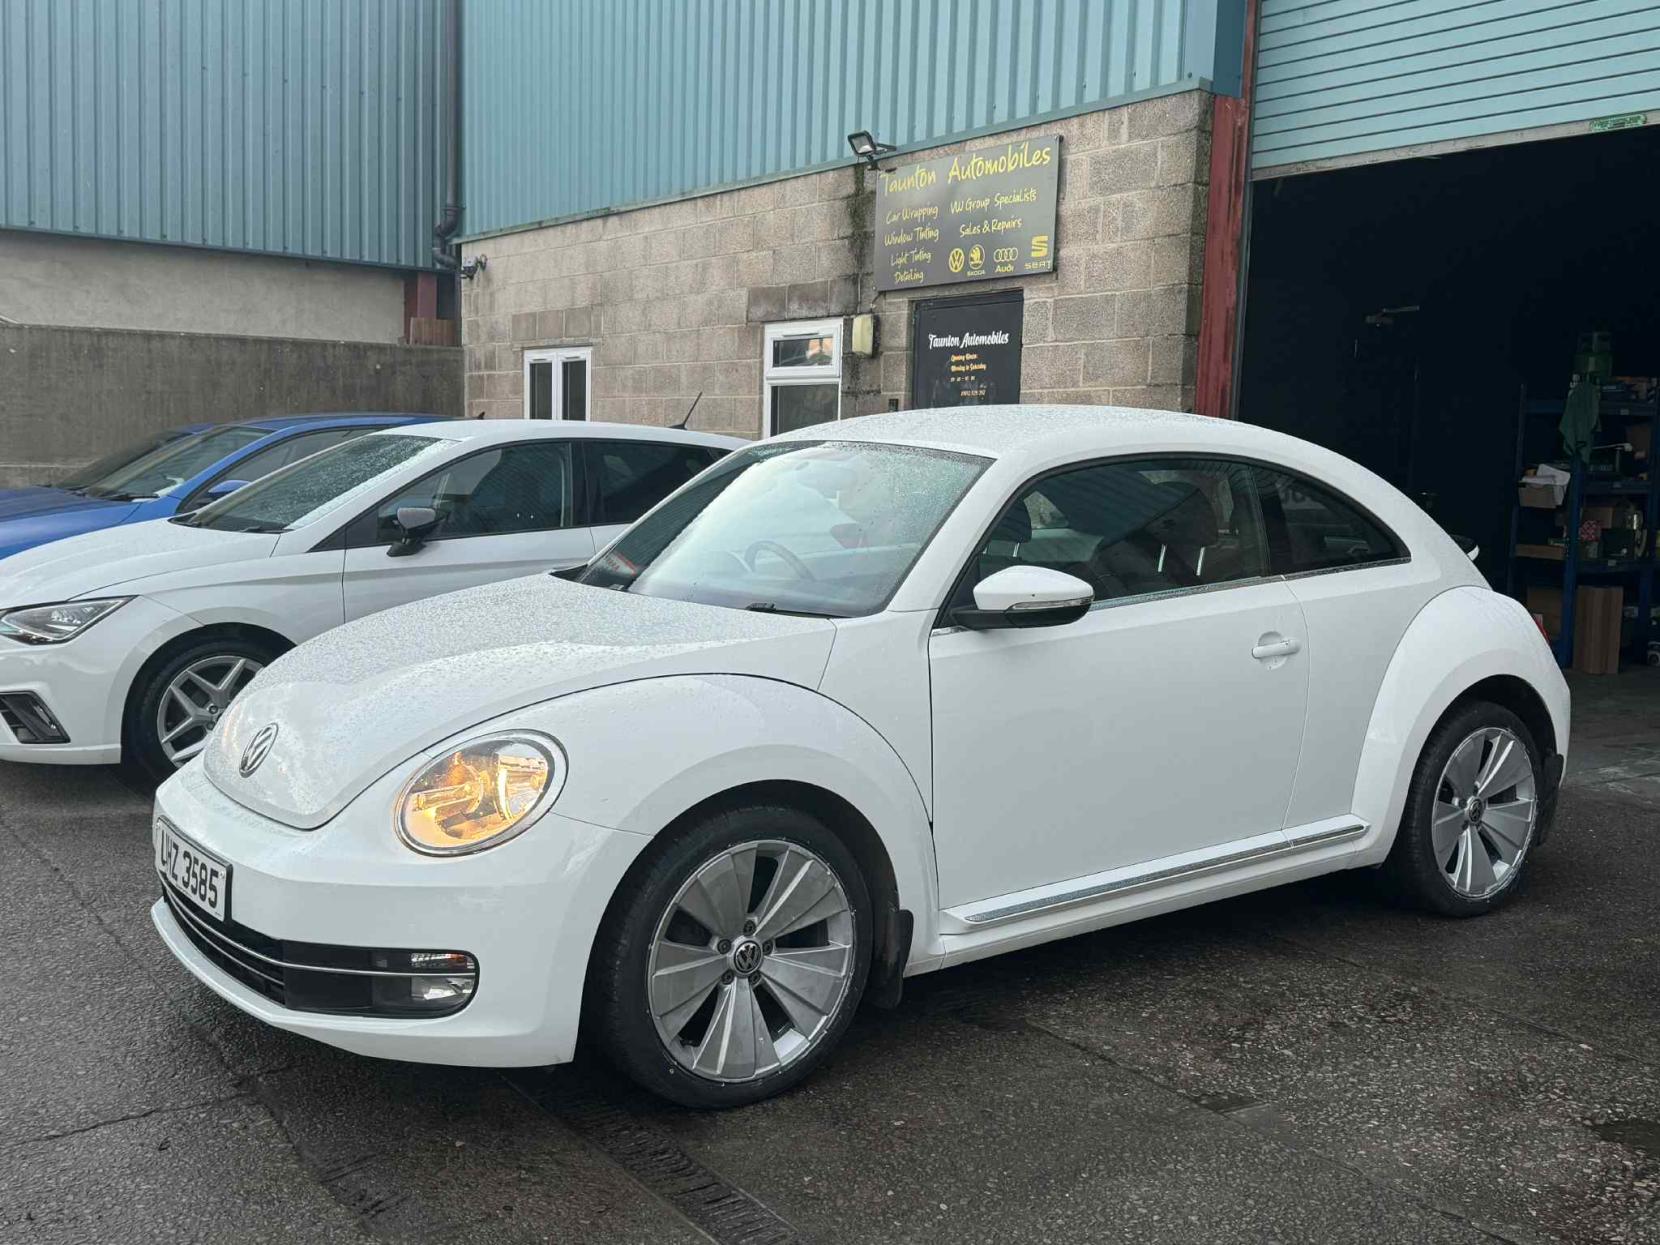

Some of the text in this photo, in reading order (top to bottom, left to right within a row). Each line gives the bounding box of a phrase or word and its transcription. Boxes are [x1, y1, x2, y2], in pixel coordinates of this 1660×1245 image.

[880, 142, 1051, 197] Taunton Automobiles
[965, 198, 990, 212] Group
[994, 187, 1037, 210] Specialists
[886, 203, 939, 225] Car Wrapping
[884, 222, 940, 247] Window Tinting
[959, 215, 1022, 238] Sales & Repairs
[894, 268, 924, 284] Detailing
[994, 264, 1014, 273] Audi
[1024, 260, 1051, 270] SEAT
[928, 330, 1010, 350] Taunton Automobiles
[182, 850, 219, 909] 3585
